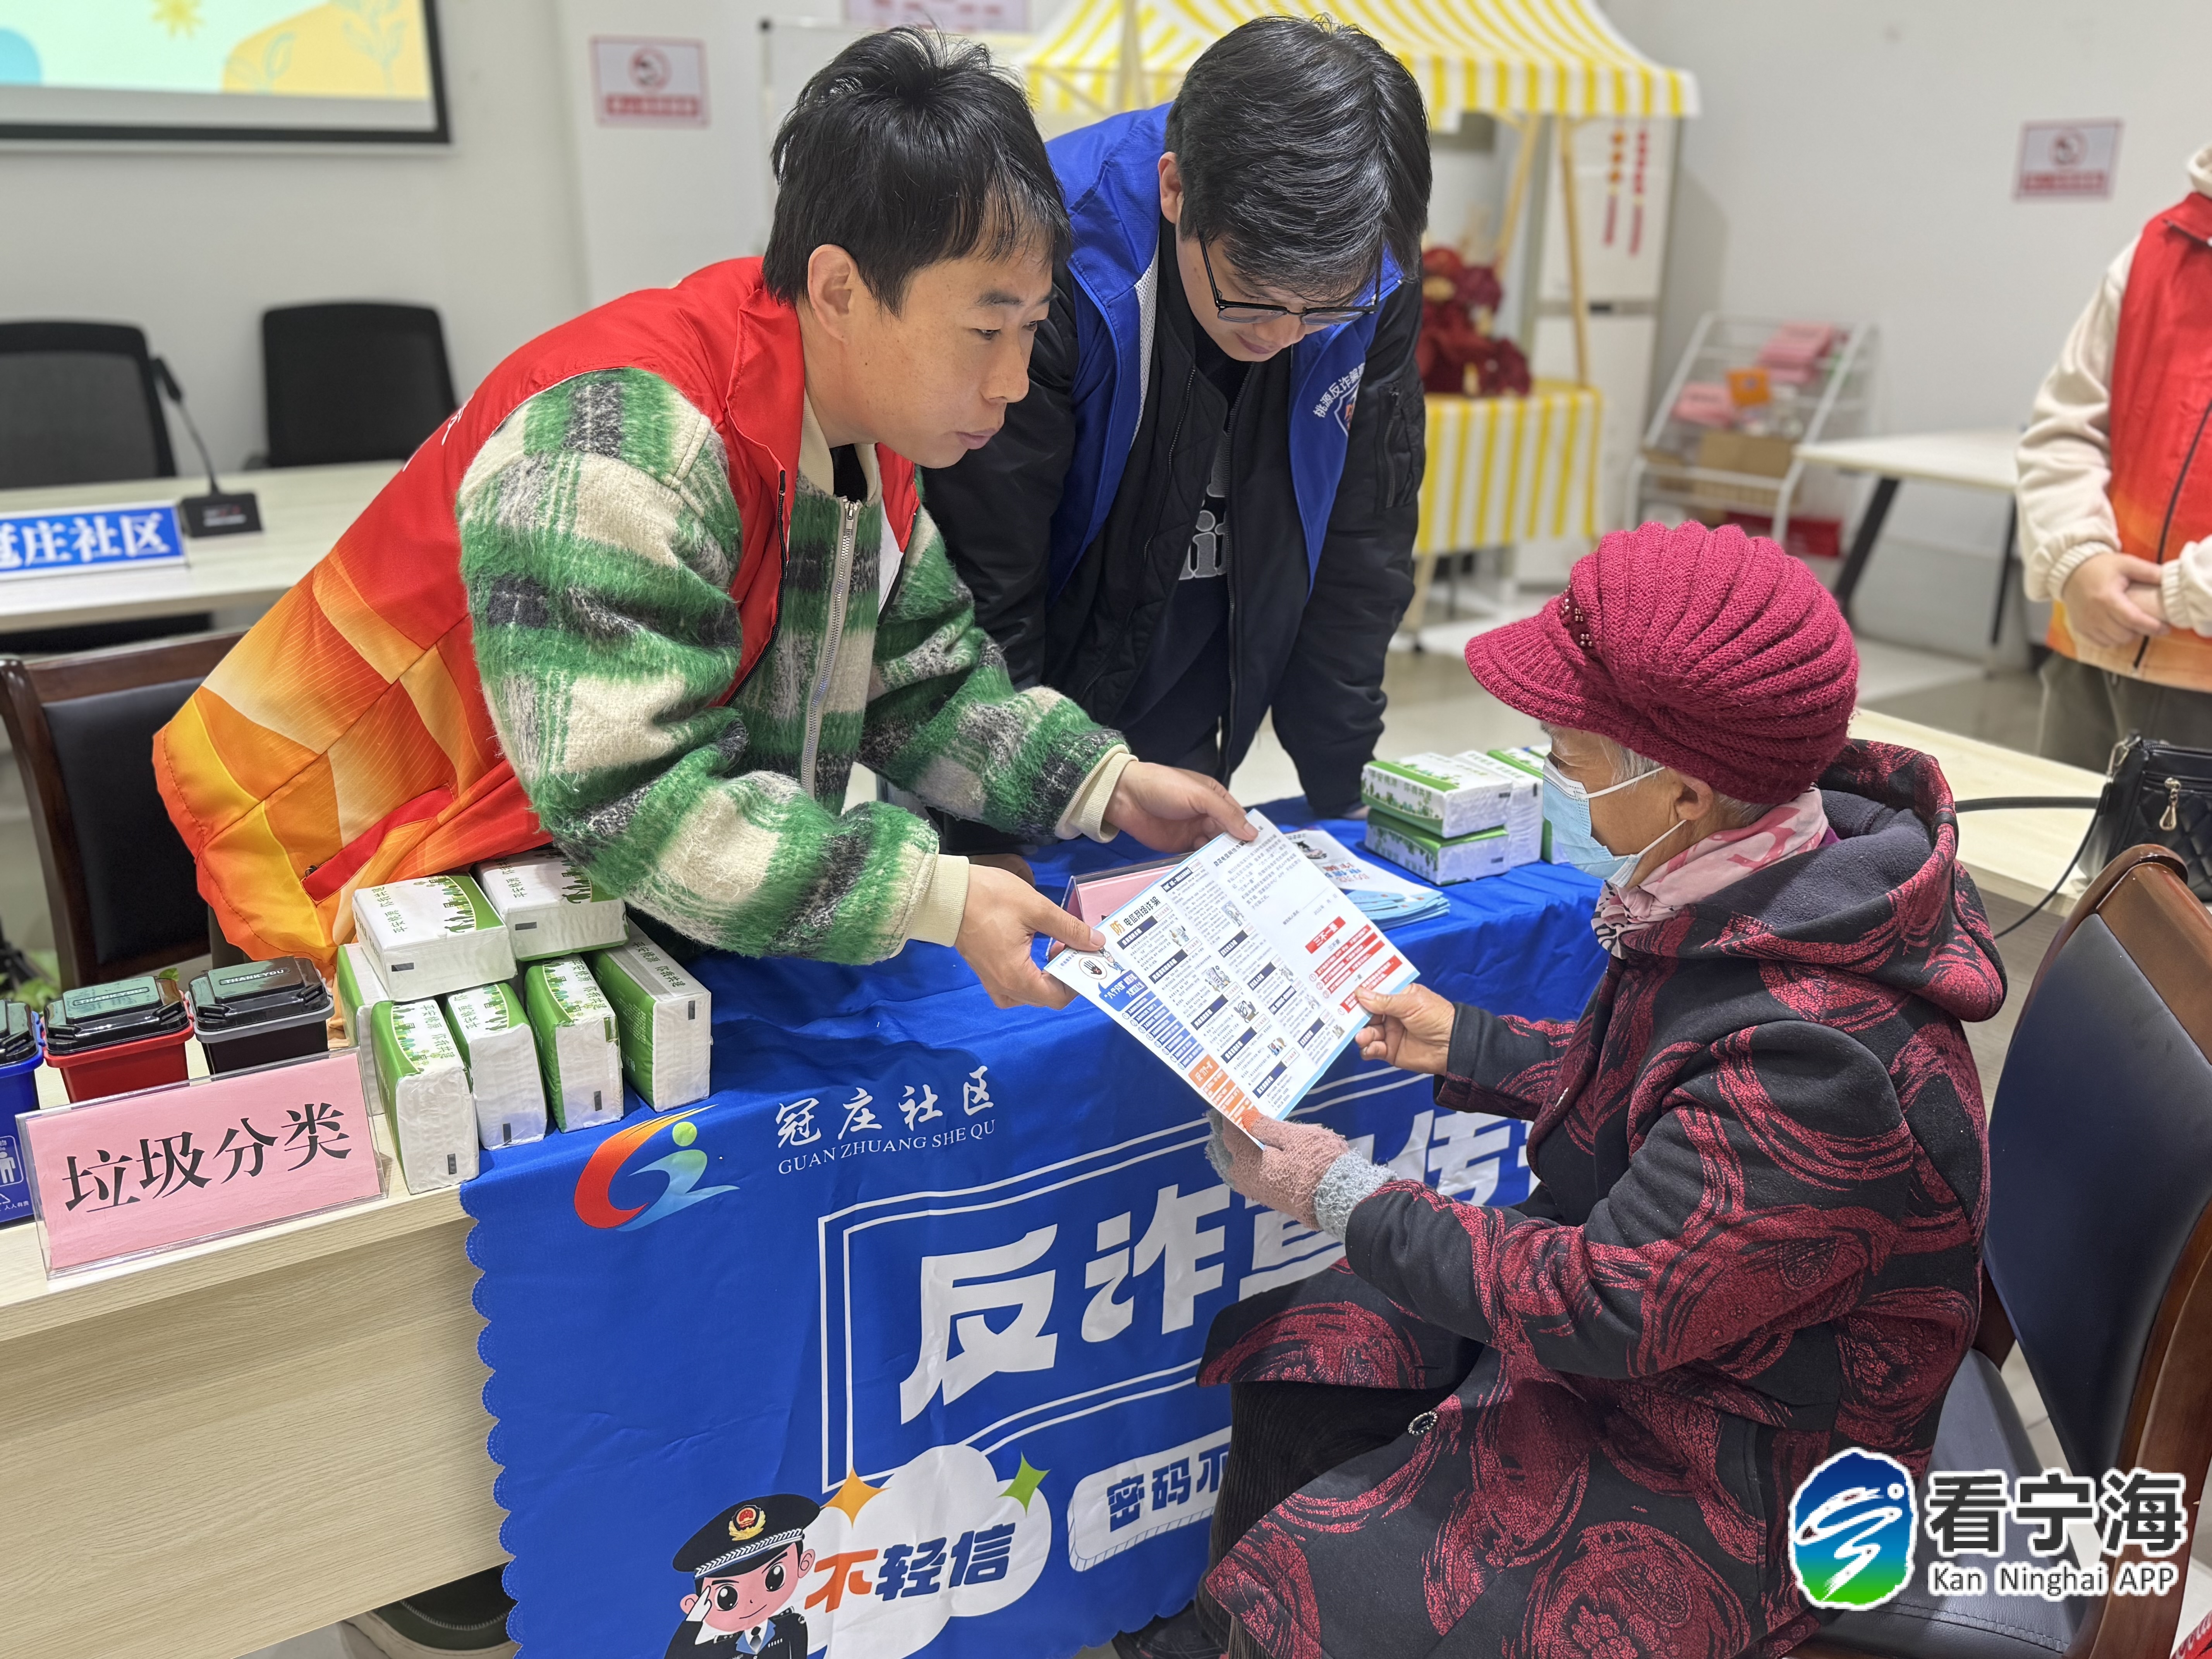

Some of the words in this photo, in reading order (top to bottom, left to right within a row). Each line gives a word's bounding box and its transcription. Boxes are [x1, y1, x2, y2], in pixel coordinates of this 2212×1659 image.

[225, 974, 261, 984] THANK
[262, 969, 284, 977] YOU
[775, 1065, 994, 1148] 冠庄社区
[778, 1147, 836, 1175] GUAN
[840, 1137, 927, 1159] ZHUANG
[932, 1127, 967, 1148] SHE
[970, 1120, 996, 1140] QU
[62, 1102, 352, 1213] 垃圾分类
[804, 1521, 1017, 1613] 不轻信
